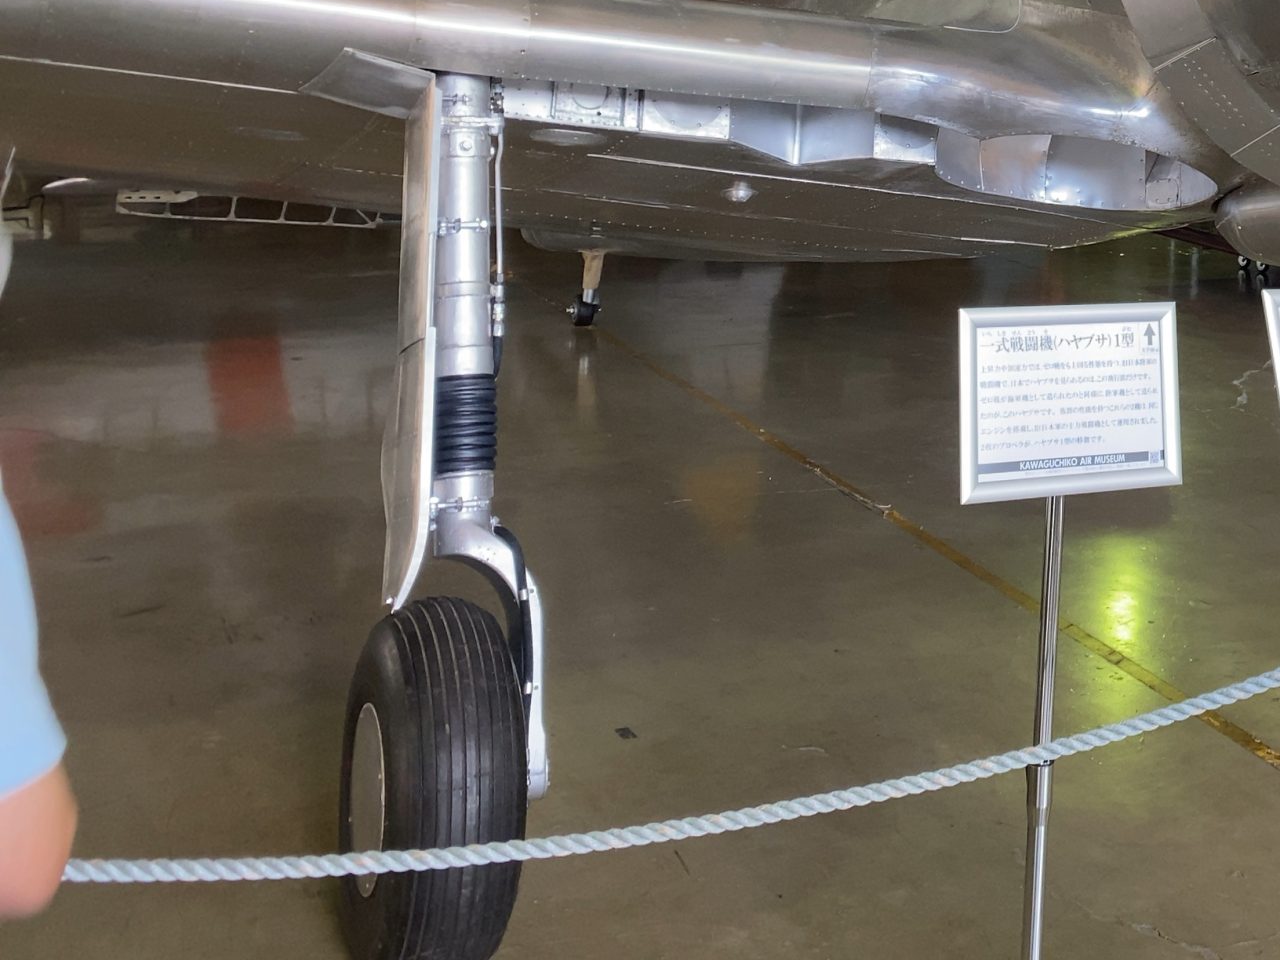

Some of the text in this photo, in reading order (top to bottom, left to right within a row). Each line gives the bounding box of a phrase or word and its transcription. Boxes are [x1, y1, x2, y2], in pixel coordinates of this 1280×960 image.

[1019, 457, 1077, 471] KAWAGUCHIKO
[1079, 456, 1091, 465] AIR
[1094, 453, 1126, 465] MUSEUM
